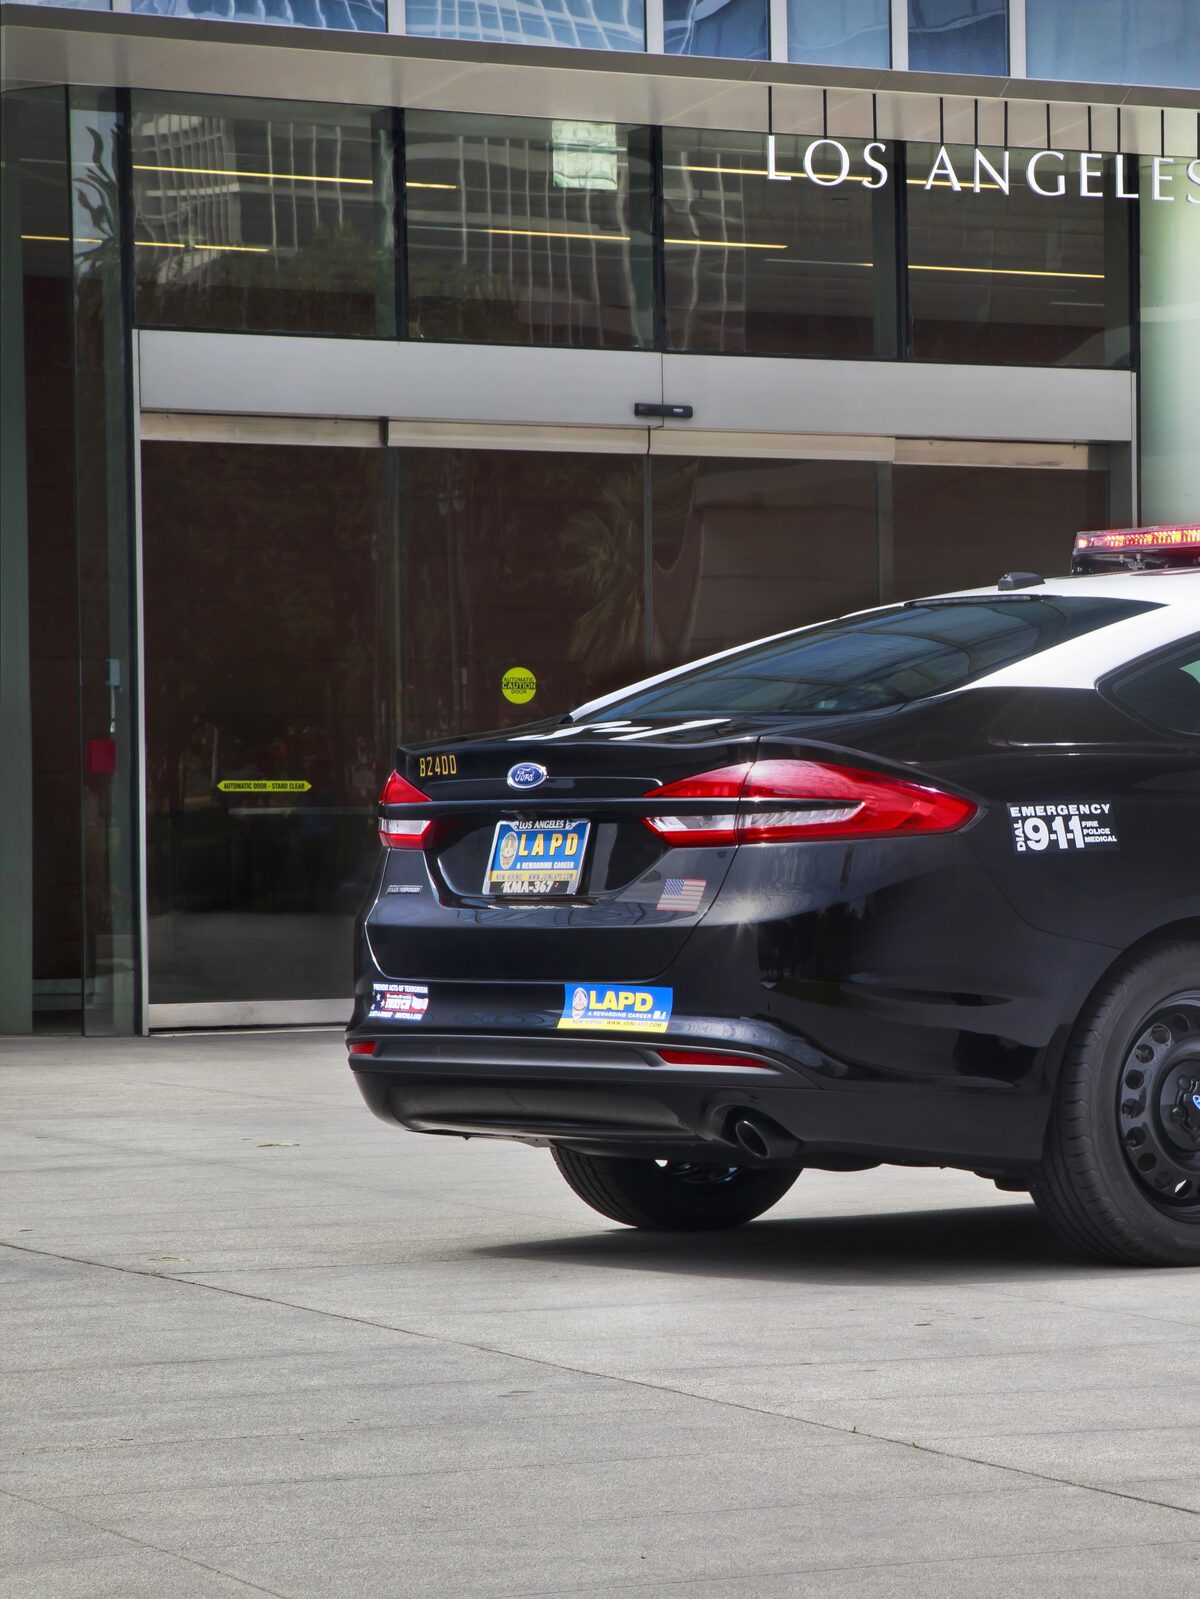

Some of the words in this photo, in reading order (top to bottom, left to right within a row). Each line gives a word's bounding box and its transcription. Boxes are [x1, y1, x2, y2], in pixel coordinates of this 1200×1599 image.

[766, 135, 889, 189] LOS
[502, 682, 536, 690] CAUTION
[223, 782, 252, 790] AUTOMATIC
[253, 782, 267, 790] DOOR
[272, 782, 288, 790] STAND
[289, 782, 305, 790] CLEAR
[1010, 803, 1110, 817] EMERGENCY
[519, 821, 533, 829] LOS
[534, 820, 565, 829] ANGELES
[1081, 820, 1099, 828] FIRE
[1013, 820, 1026, 851] DIAL
[1024, 815, 1085, 851] 9-1-1
[1084, 835, 1118, 843] MEDICAL
[518, 833, 579, 856] LAPD
[553, 861, 575, 869] CAREER
[503, 880, 554, 893] KMA-367
[588, 990, 654, 1012] LAPD
